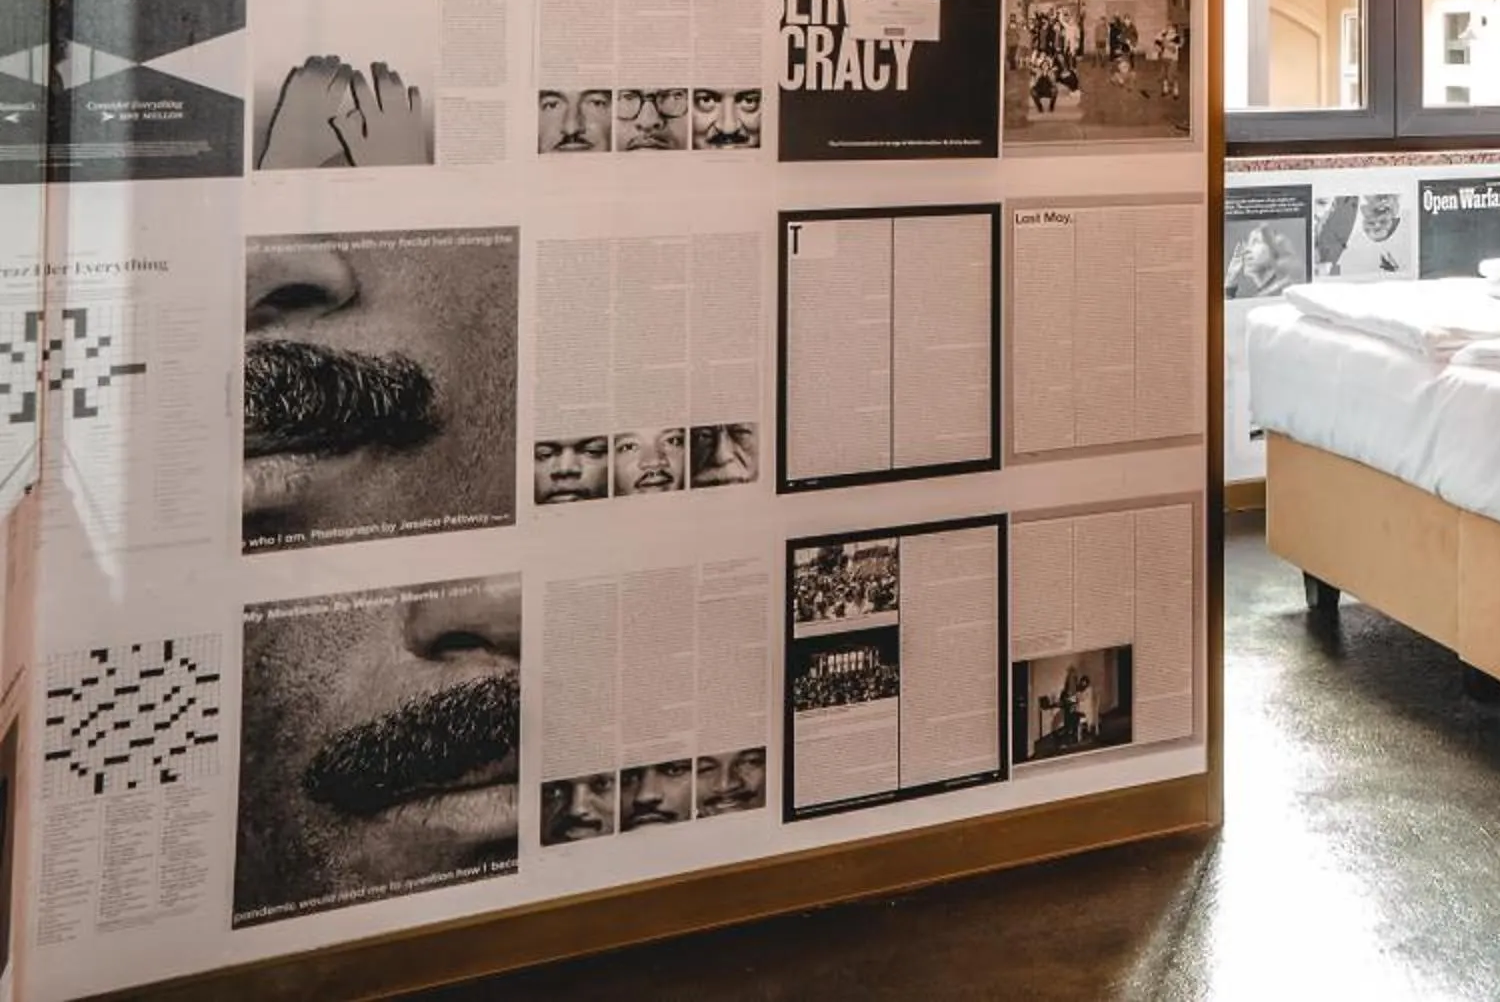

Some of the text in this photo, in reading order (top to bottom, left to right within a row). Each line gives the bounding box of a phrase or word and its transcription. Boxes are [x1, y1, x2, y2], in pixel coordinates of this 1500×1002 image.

[779, 25, 915, 91] CRACY
[1423, 188, 1458, 215] Open
[311, 523, 380, 540] Photograph
[381, 521, 397, 534] by
[399, 516, 441, 531] Jessica
[234, 900, 297, 924] pandemic
[456, 865, 481, 879] how
